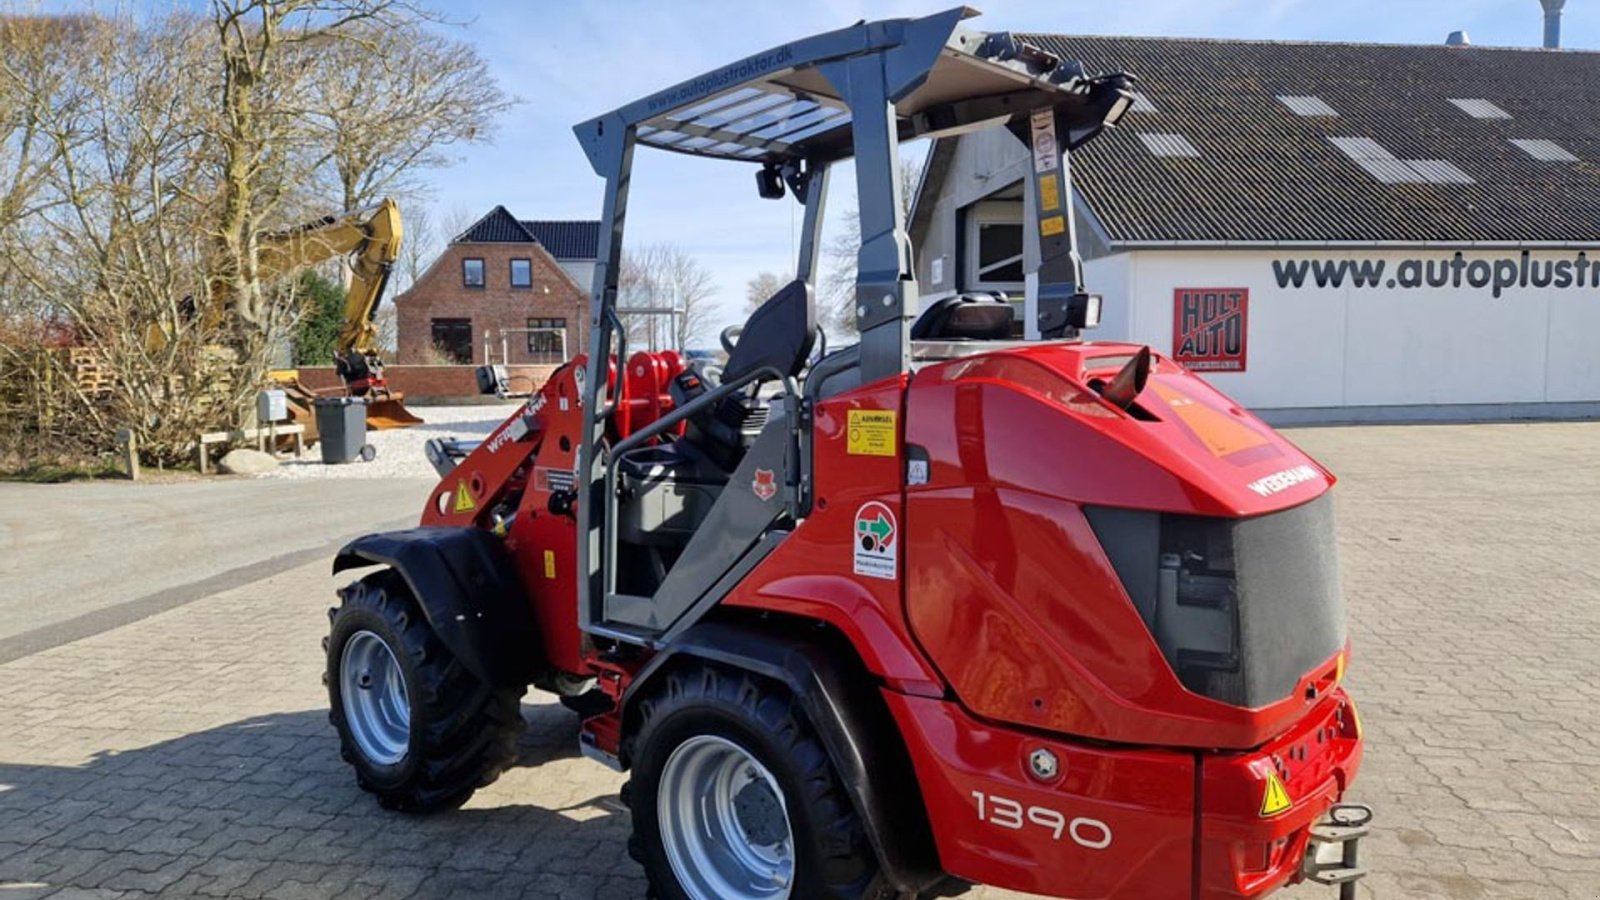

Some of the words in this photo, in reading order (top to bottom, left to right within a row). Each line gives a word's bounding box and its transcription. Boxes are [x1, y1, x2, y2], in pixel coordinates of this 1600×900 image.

[647, 45, 793, 110] www.autoplustraktor.dk
[1178, 312, 1242, 357] AUTO
[1182, 292, 1242, 335] HOLT
[971, 790, 1113, 850] 1390
